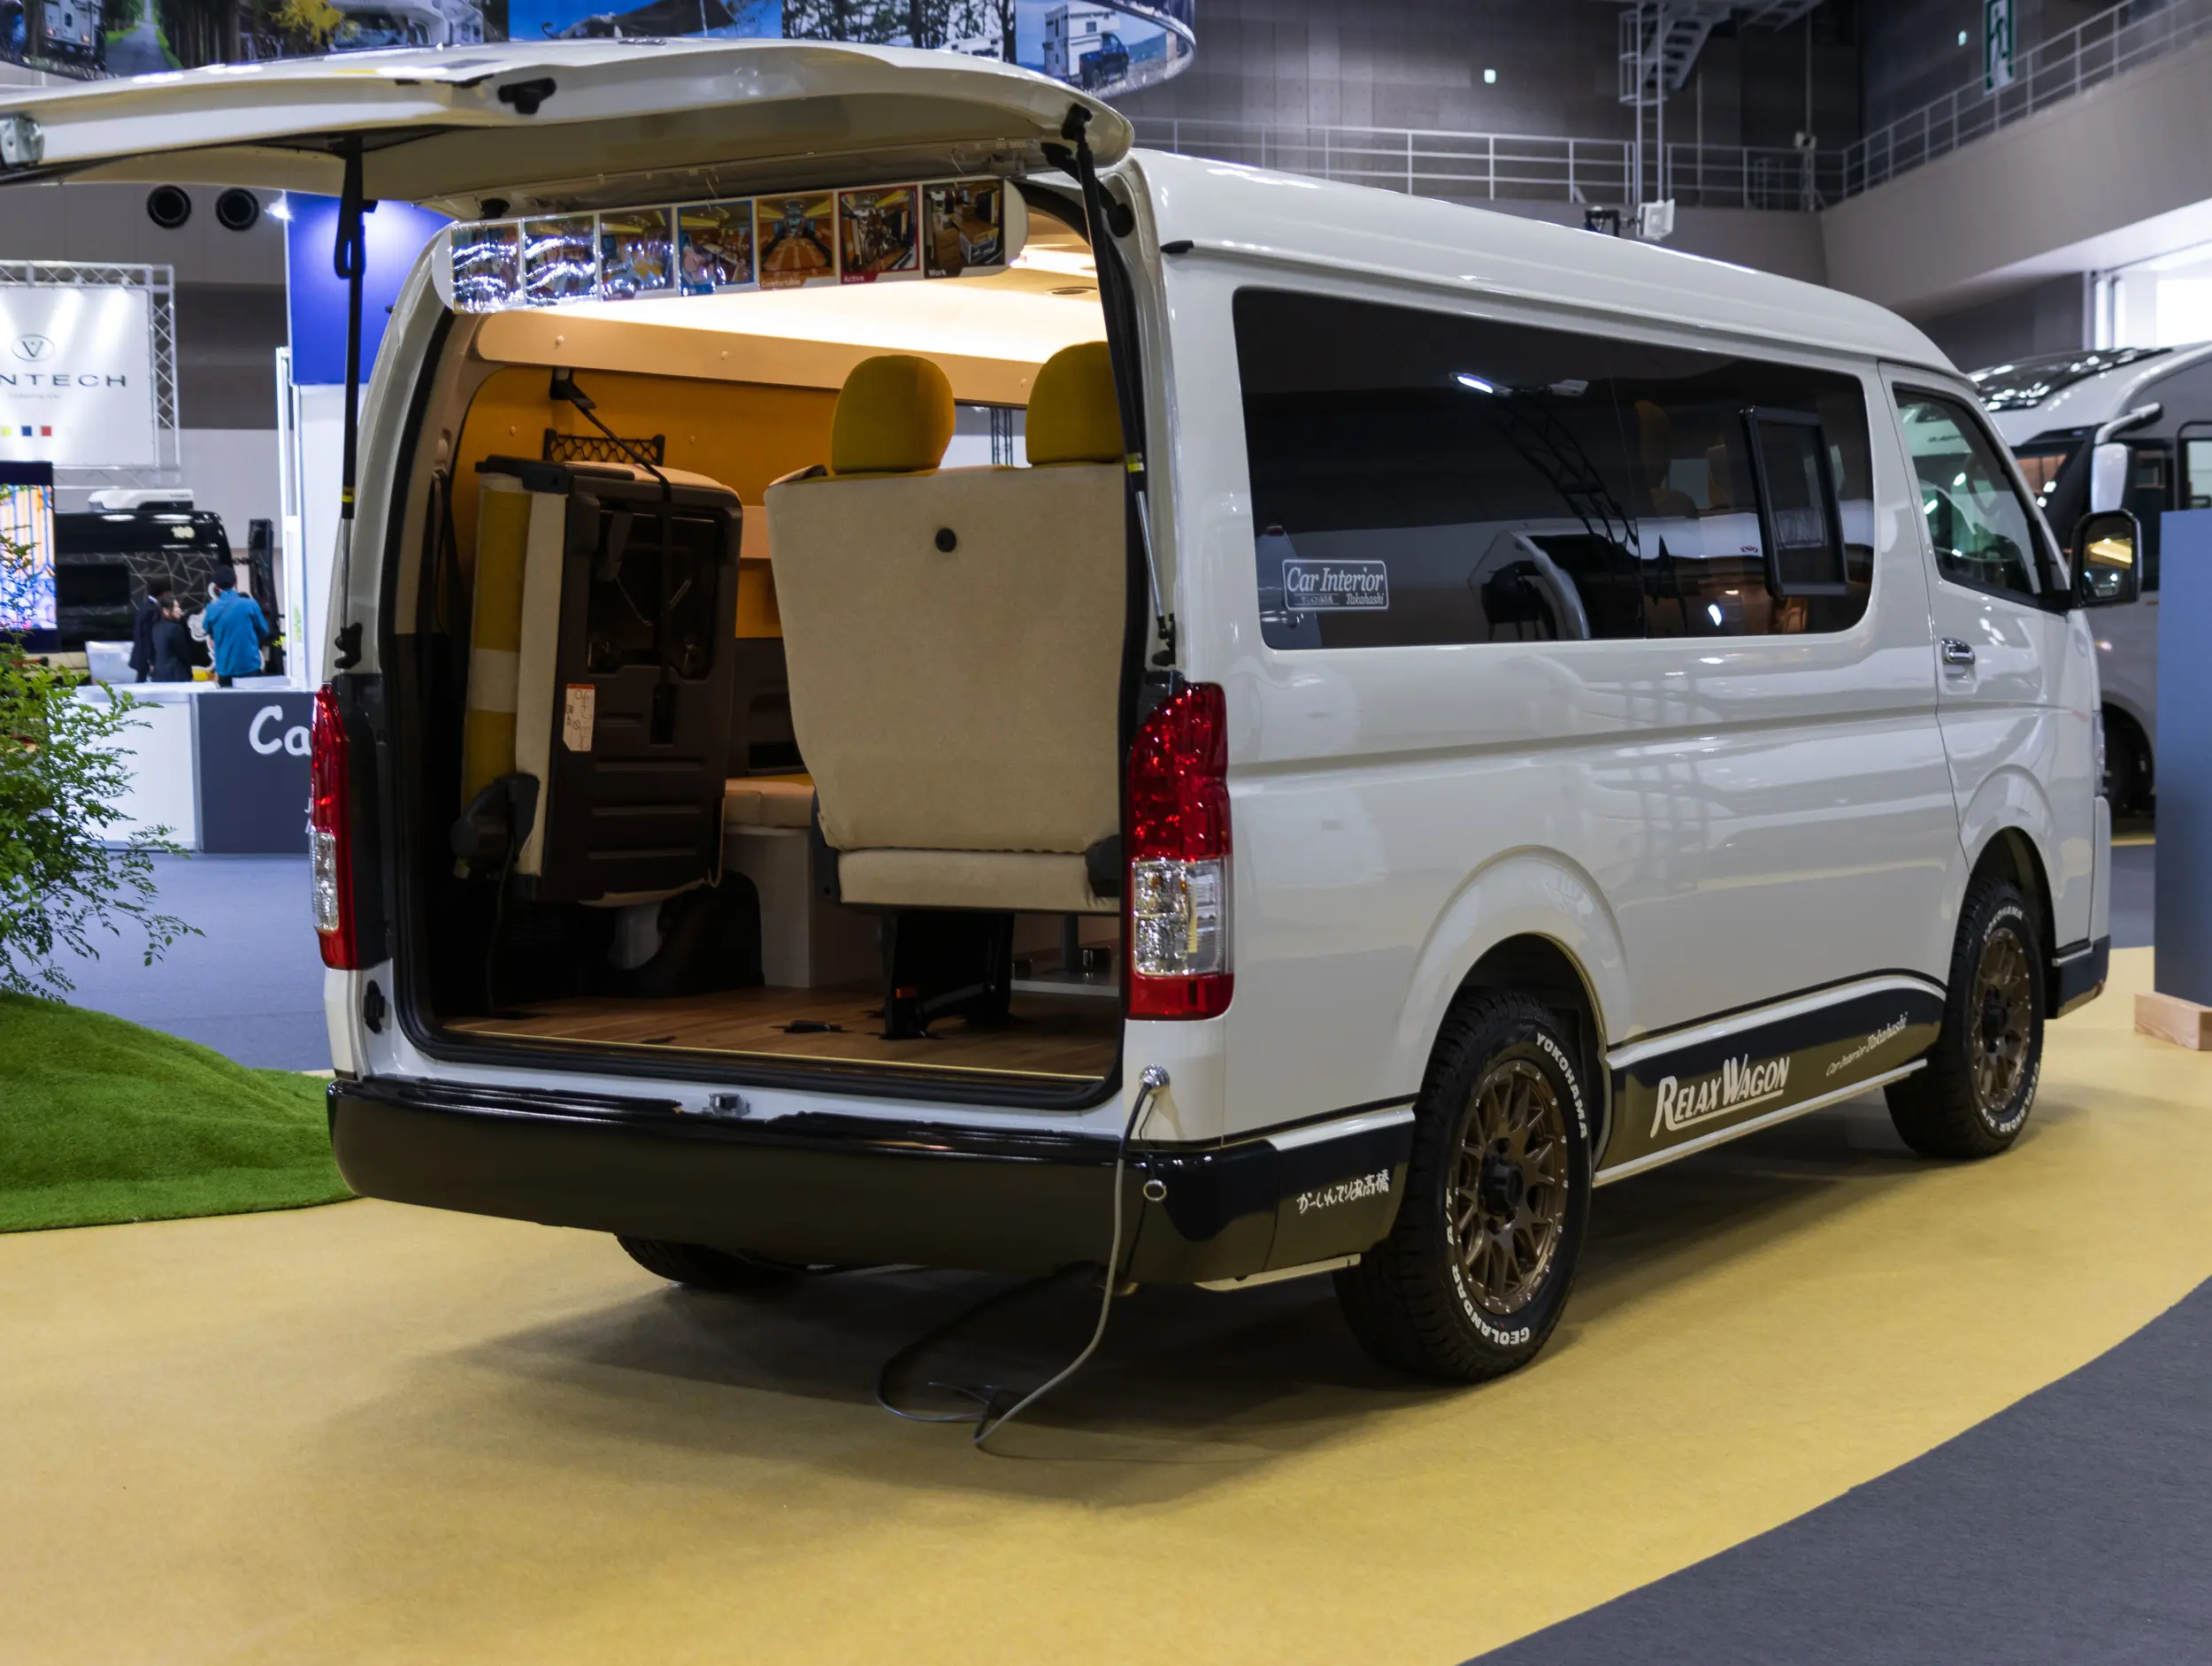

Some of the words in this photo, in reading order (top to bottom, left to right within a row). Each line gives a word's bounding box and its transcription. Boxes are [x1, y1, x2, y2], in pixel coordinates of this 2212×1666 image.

[928, 268, 947, 277] Work
[761, 278, 801, 288] Comfortable
[1286, 566, 1320, 592] Car
[1319, 566, 1384, 592] Interior
[1346, 592, 1385, 605] Takahashi
[1536, 1032, 1588, 1140] YOKOHAMA
[1451, 1263, 1530, 1345] GEOLANDAR
